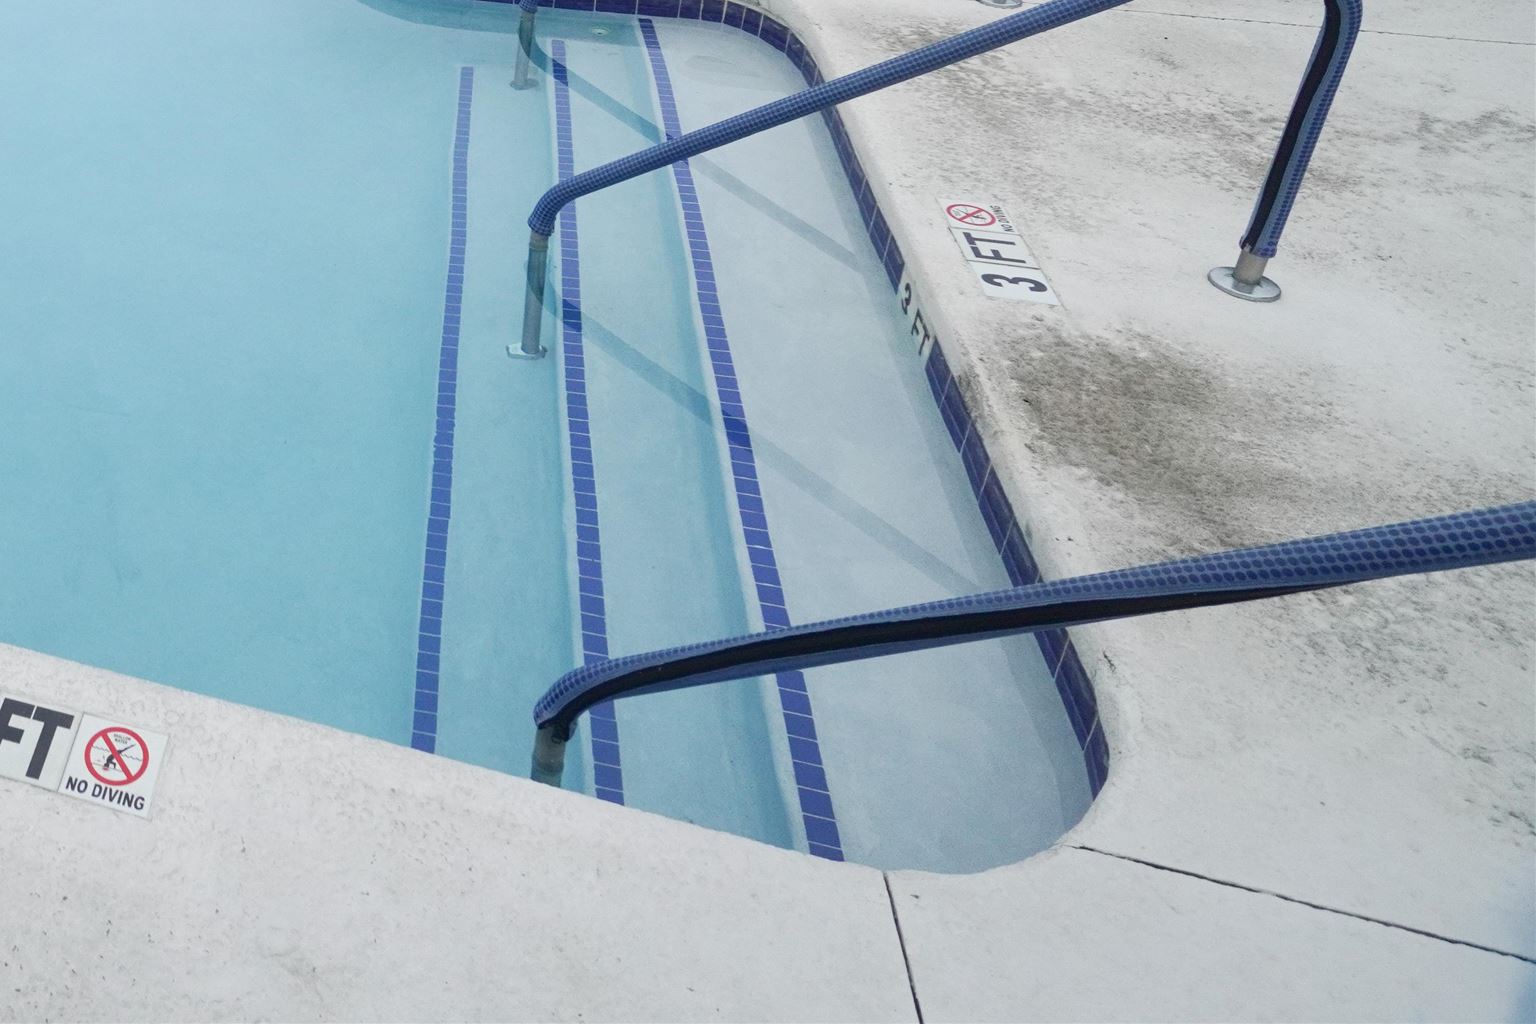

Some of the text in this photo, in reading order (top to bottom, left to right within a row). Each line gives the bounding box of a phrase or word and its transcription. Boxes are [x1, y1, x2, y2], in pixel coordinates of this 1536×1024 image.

[963, 232, 1048, 292] 3 FT
[911, 307, 930, 356] FT
[65, 776, 145, 811] NO DIVING
